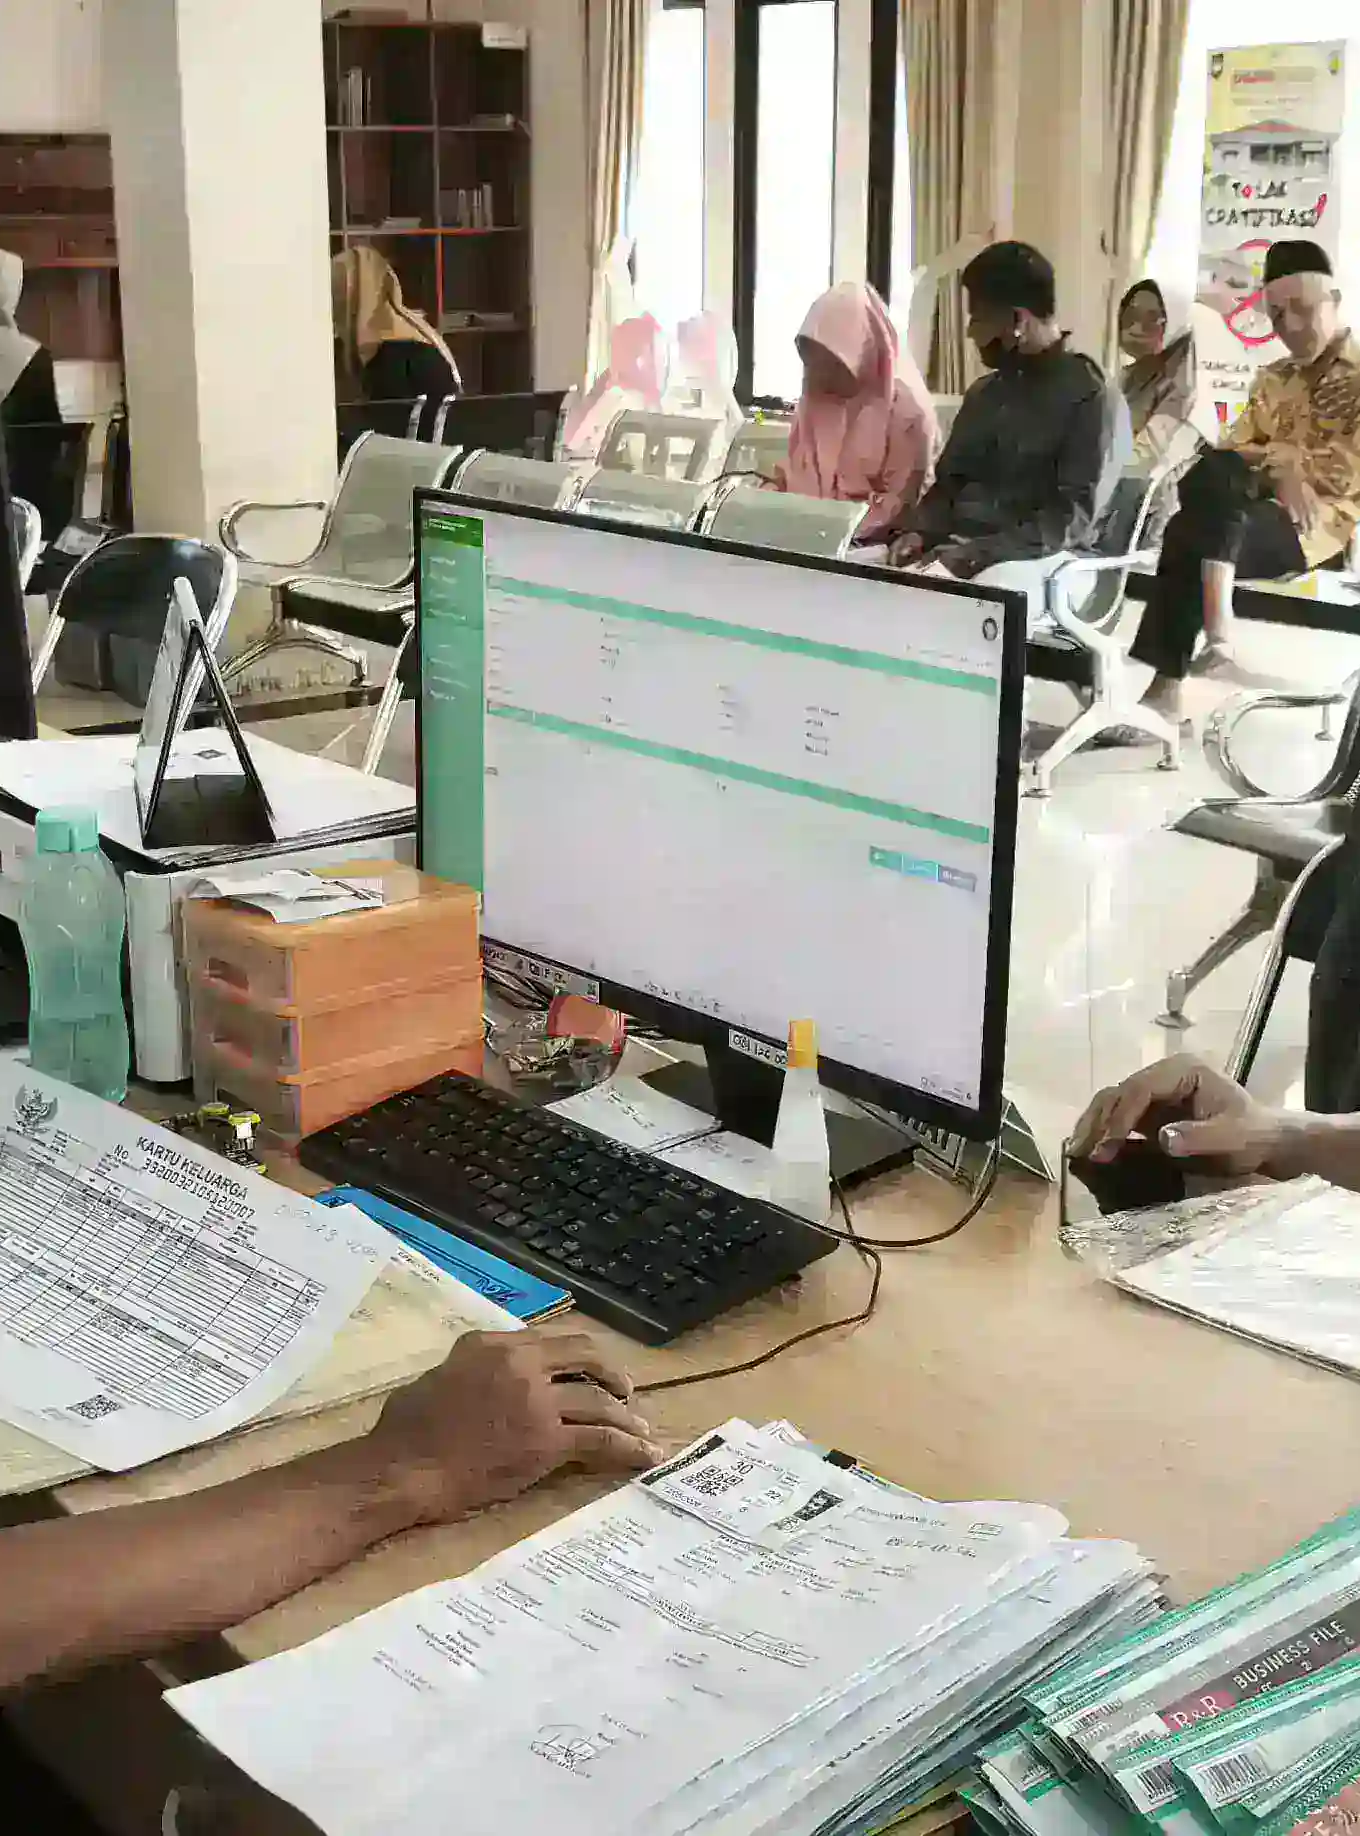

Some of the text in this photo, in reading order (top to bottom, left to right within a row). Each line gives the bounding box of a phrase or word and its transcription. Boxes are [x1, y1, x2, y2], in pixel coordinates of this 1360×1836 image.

[135, 1136, 249, 1201] KARTU KELUARGA
[1232, 1639, 1311, 1689] BUSINESS
[1309, 1619, 1346, 1646] FILE
